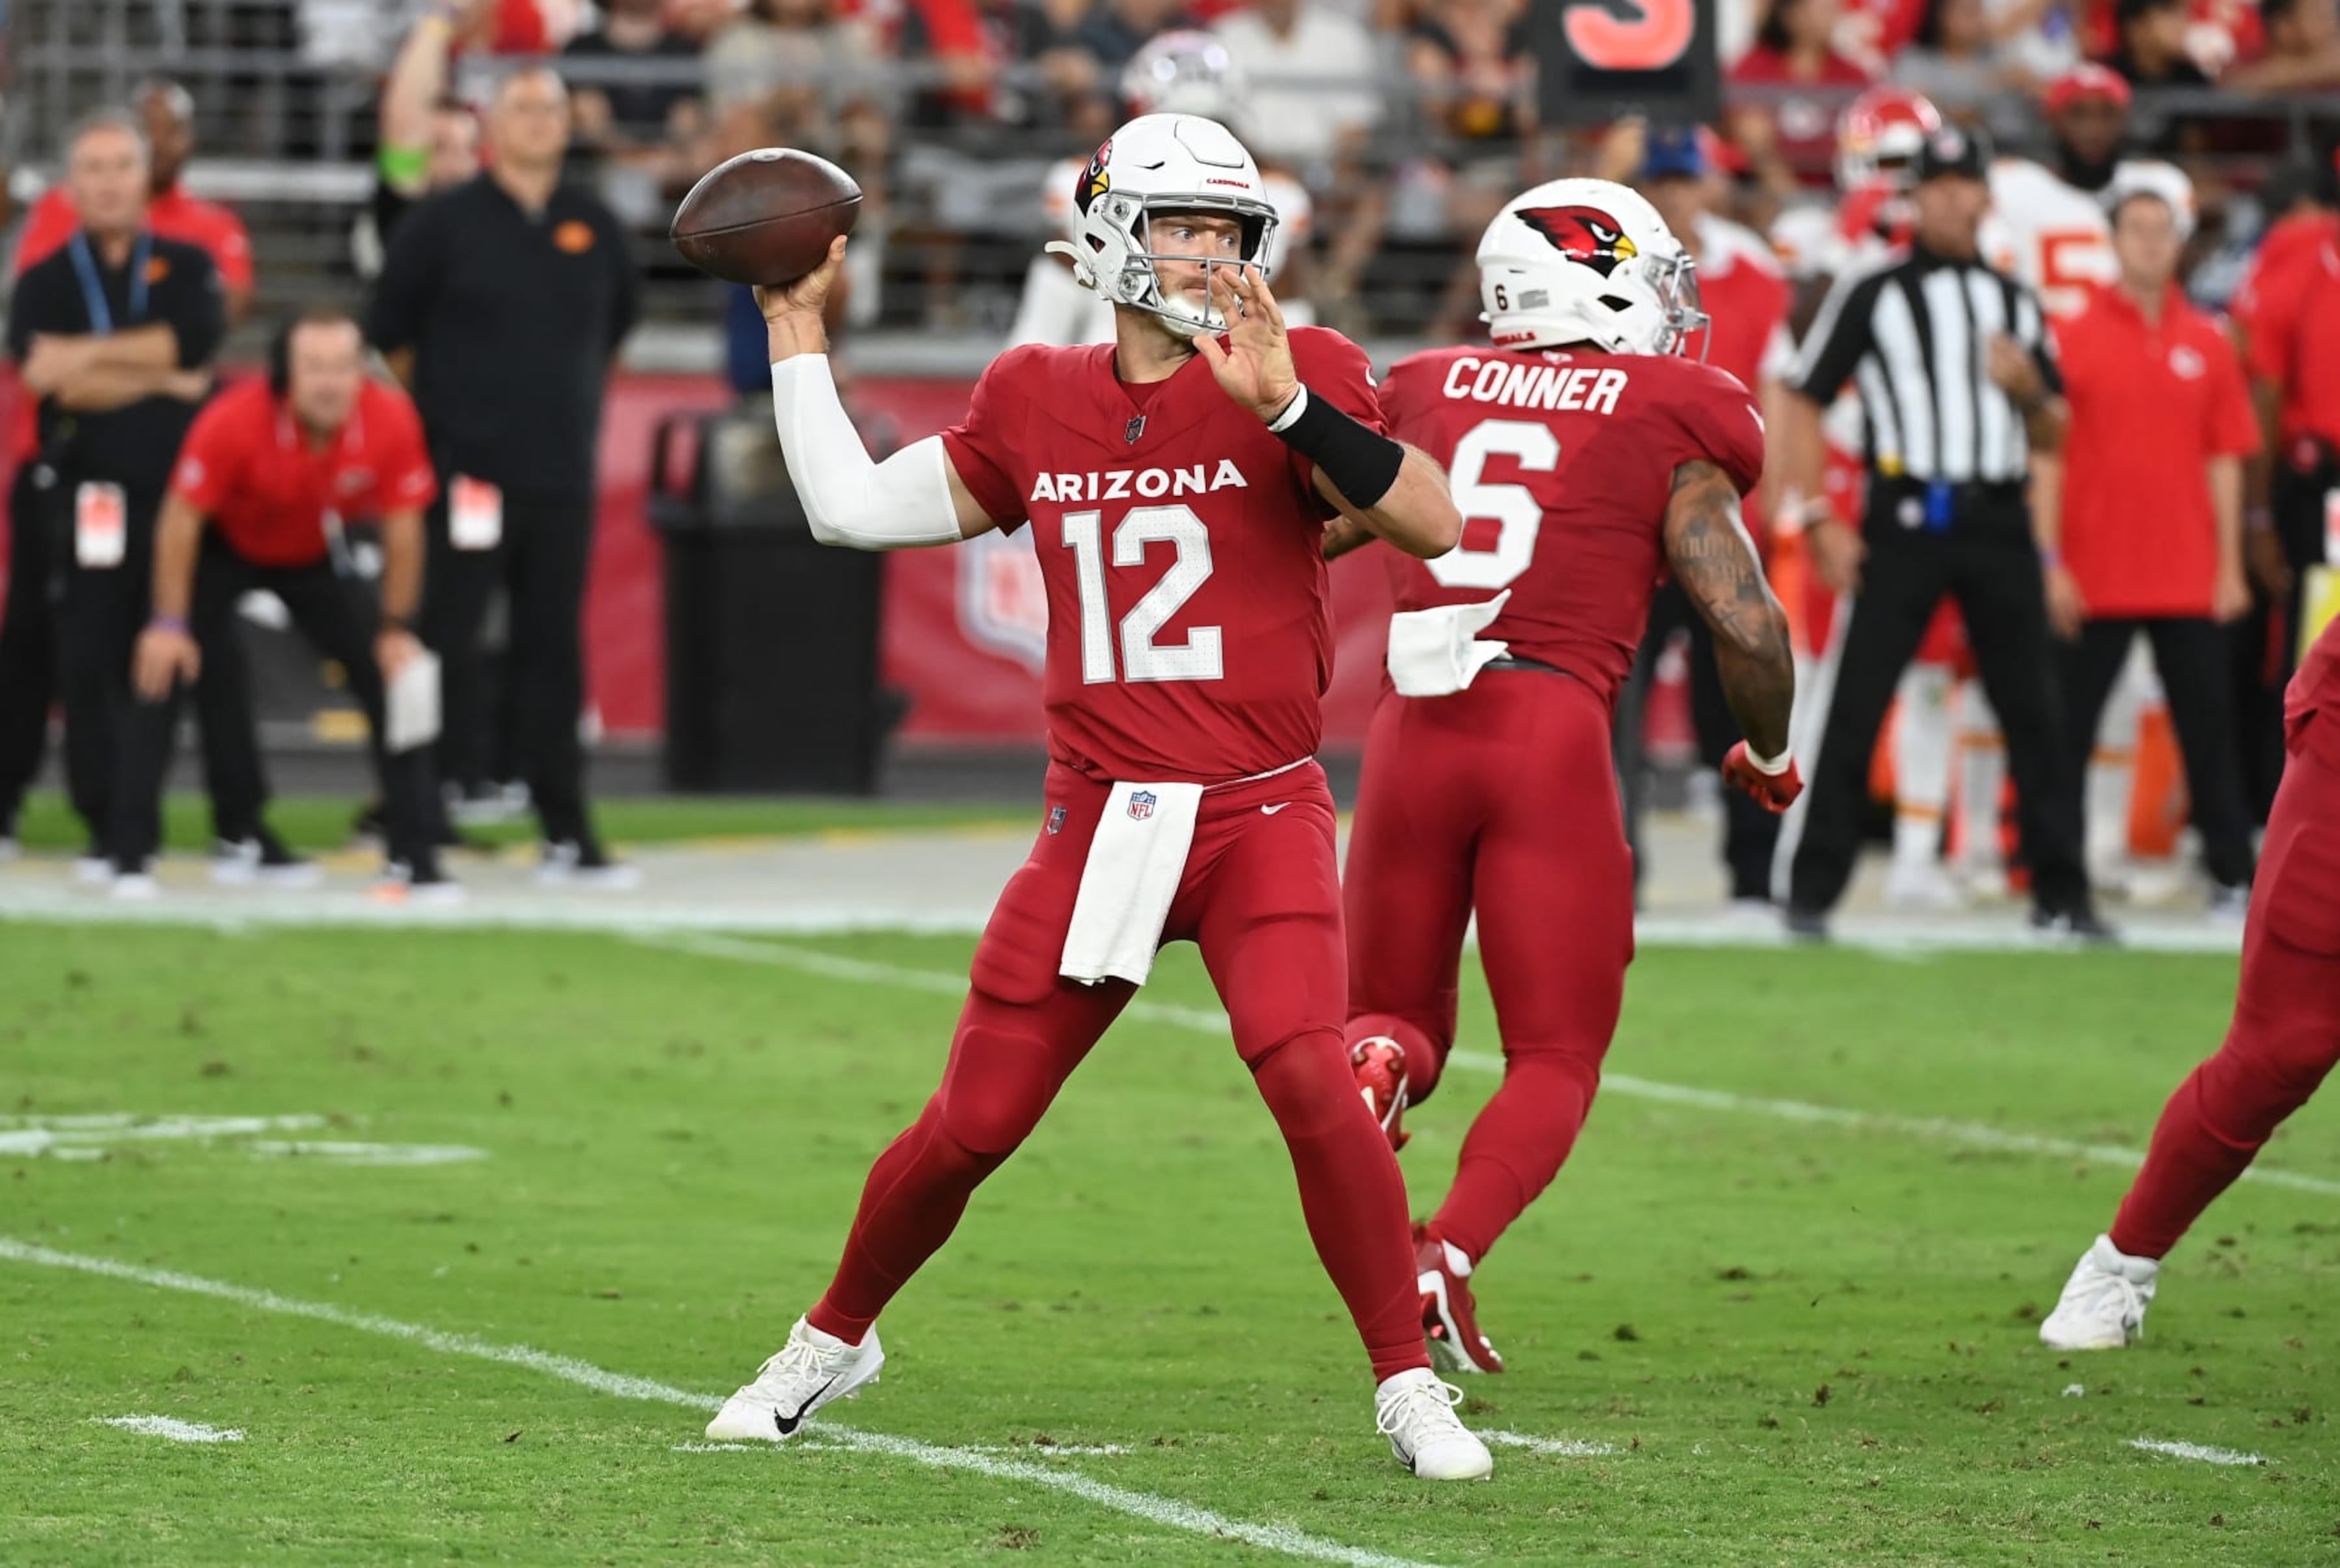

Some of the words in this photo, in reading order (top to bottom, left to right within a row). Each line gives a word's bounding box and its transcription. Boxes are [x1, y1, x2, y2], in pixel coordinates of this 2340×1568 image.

[1495, 283, 1509, 311] 6
[1442, 357, 1629, 415] CONNER
[1030, 458, 1249, 503] ARIZONA
[1424, 418, 1561, 589] 6
[1062, 503, 1224, 685] 12
[1130, 802, 1151, 817] NFL
